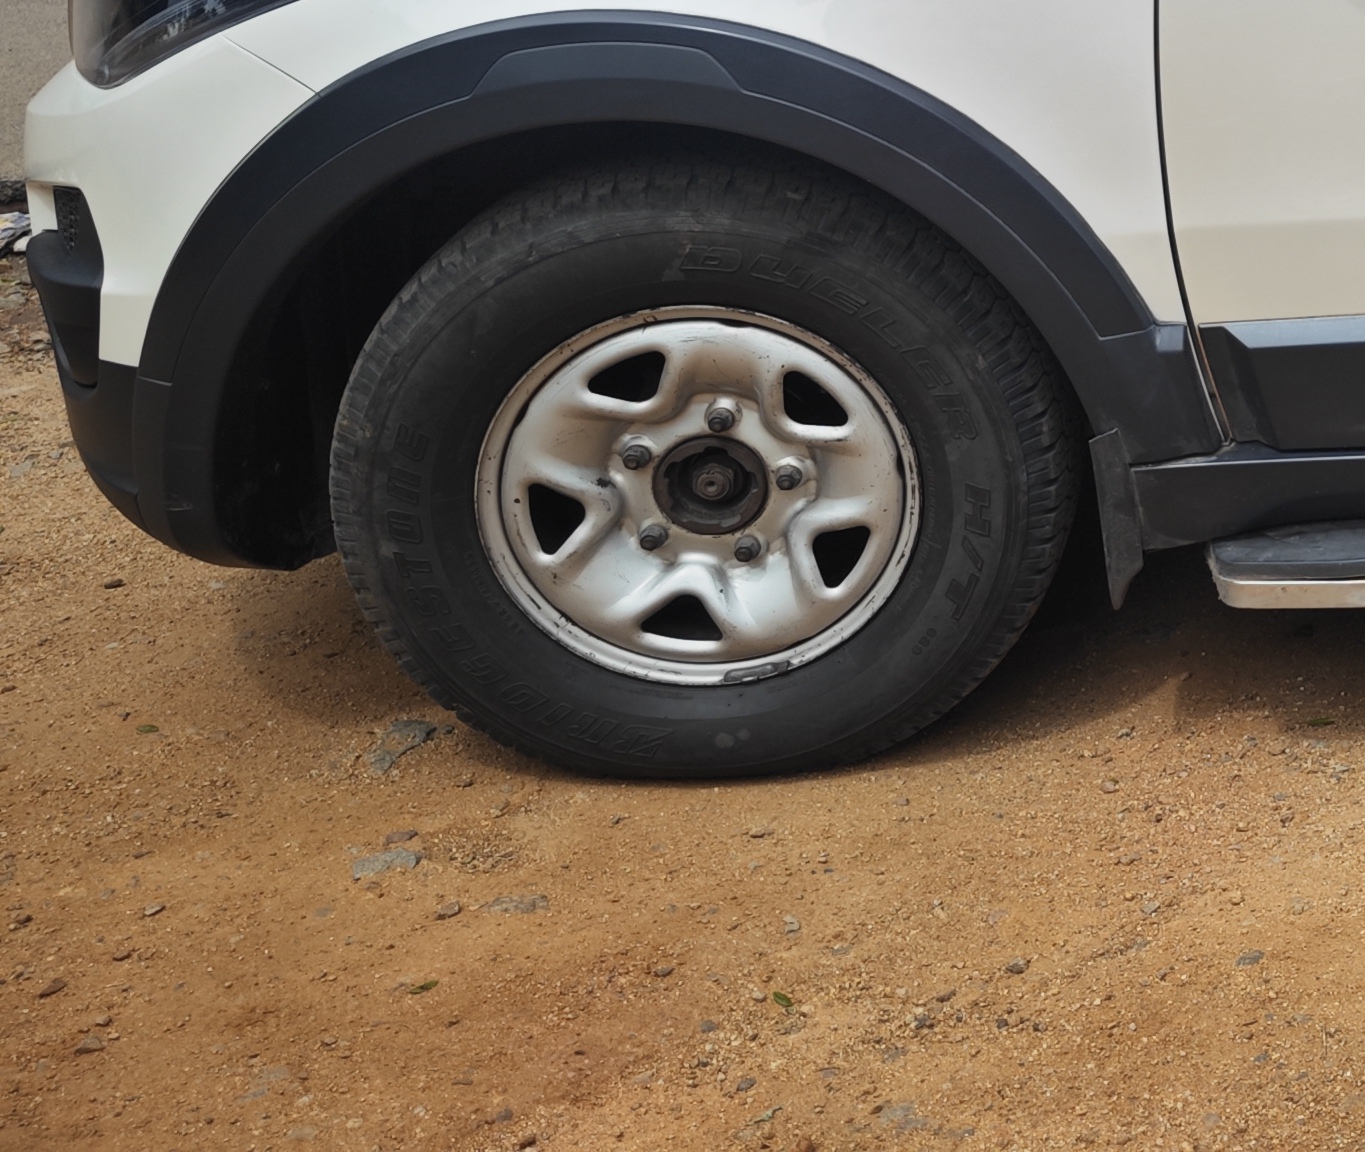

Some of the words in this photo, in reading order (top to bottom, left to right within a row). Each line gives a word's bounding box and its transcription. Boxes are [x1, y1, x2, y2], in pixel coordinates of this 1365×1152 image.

[385, 422, 675, 758] BRIDGESTONE
[680, 245, 980, 442] DUELER
[944, 482, 992, 622] H/T
